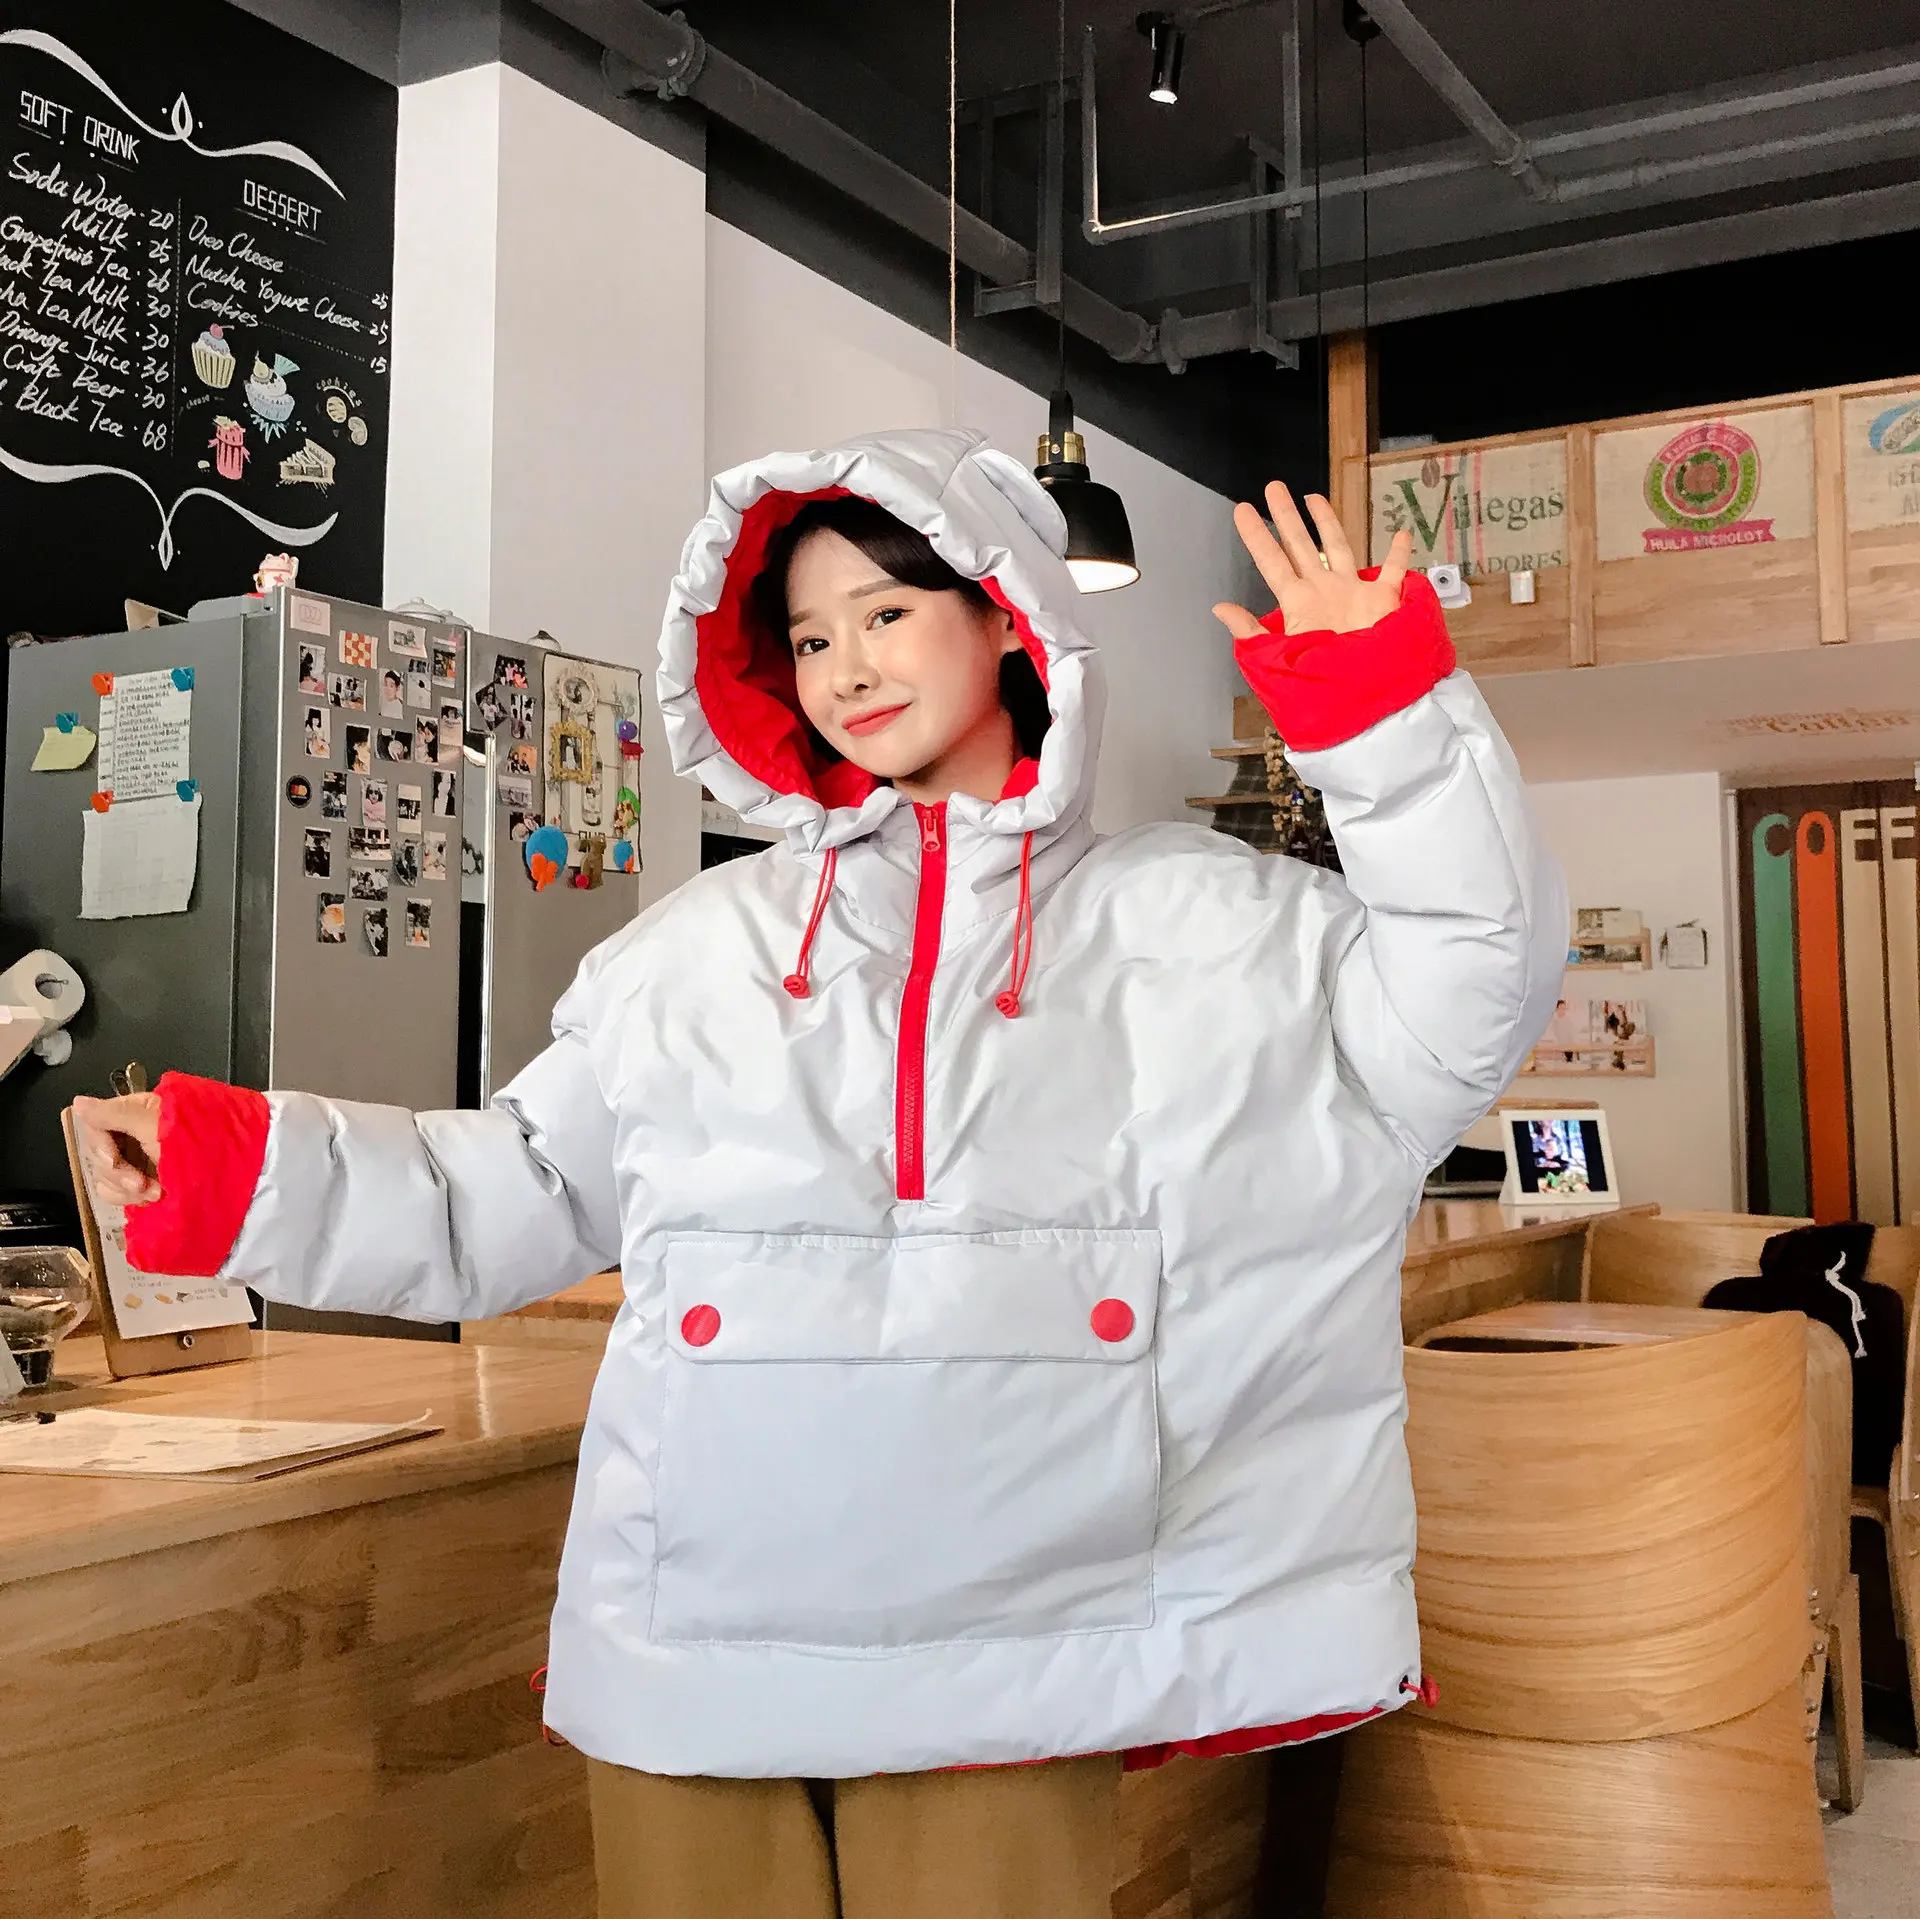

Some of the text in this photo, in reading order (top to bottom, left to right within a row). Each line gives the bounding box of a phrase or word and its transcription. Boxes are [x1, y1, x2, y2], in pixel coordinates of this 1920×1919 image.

[20, 90, 141, 164] SOFT DRINK
[8, 152, 174, 230] Soda Water 20
[243, 179, 322, 231] DESSERT
[1, 216, 93, 269] Grapefruit
[98, 246, 131, 281] Tea
[61, 209, 173, 264] Milk 25
[42, 259, 73, 293] Tea
[78, 276, 129, 312] Milk
[147, 294, 171, 318] 30
[228, 233, 284, 273] Cheese
[371, 292, 389, 310] 25
[37, 286, 71, 324] Tea
[73, 305, 128, 343] Milk
[142, 324, 169, 351] 30
[187, 282, 388, 374] Cookies 15
[314, 297, 360, 333] Cheese
[369, 319, 389, 345] 25
[73, 364, 125, 398] Beer
[142, 385, 165, 408] 30
[75, 335, 130, 375] Juice
[141, 356, 169, 383] 36
[90, 399, 124, 437] Tea
[143, 420, 167, 450] 68
